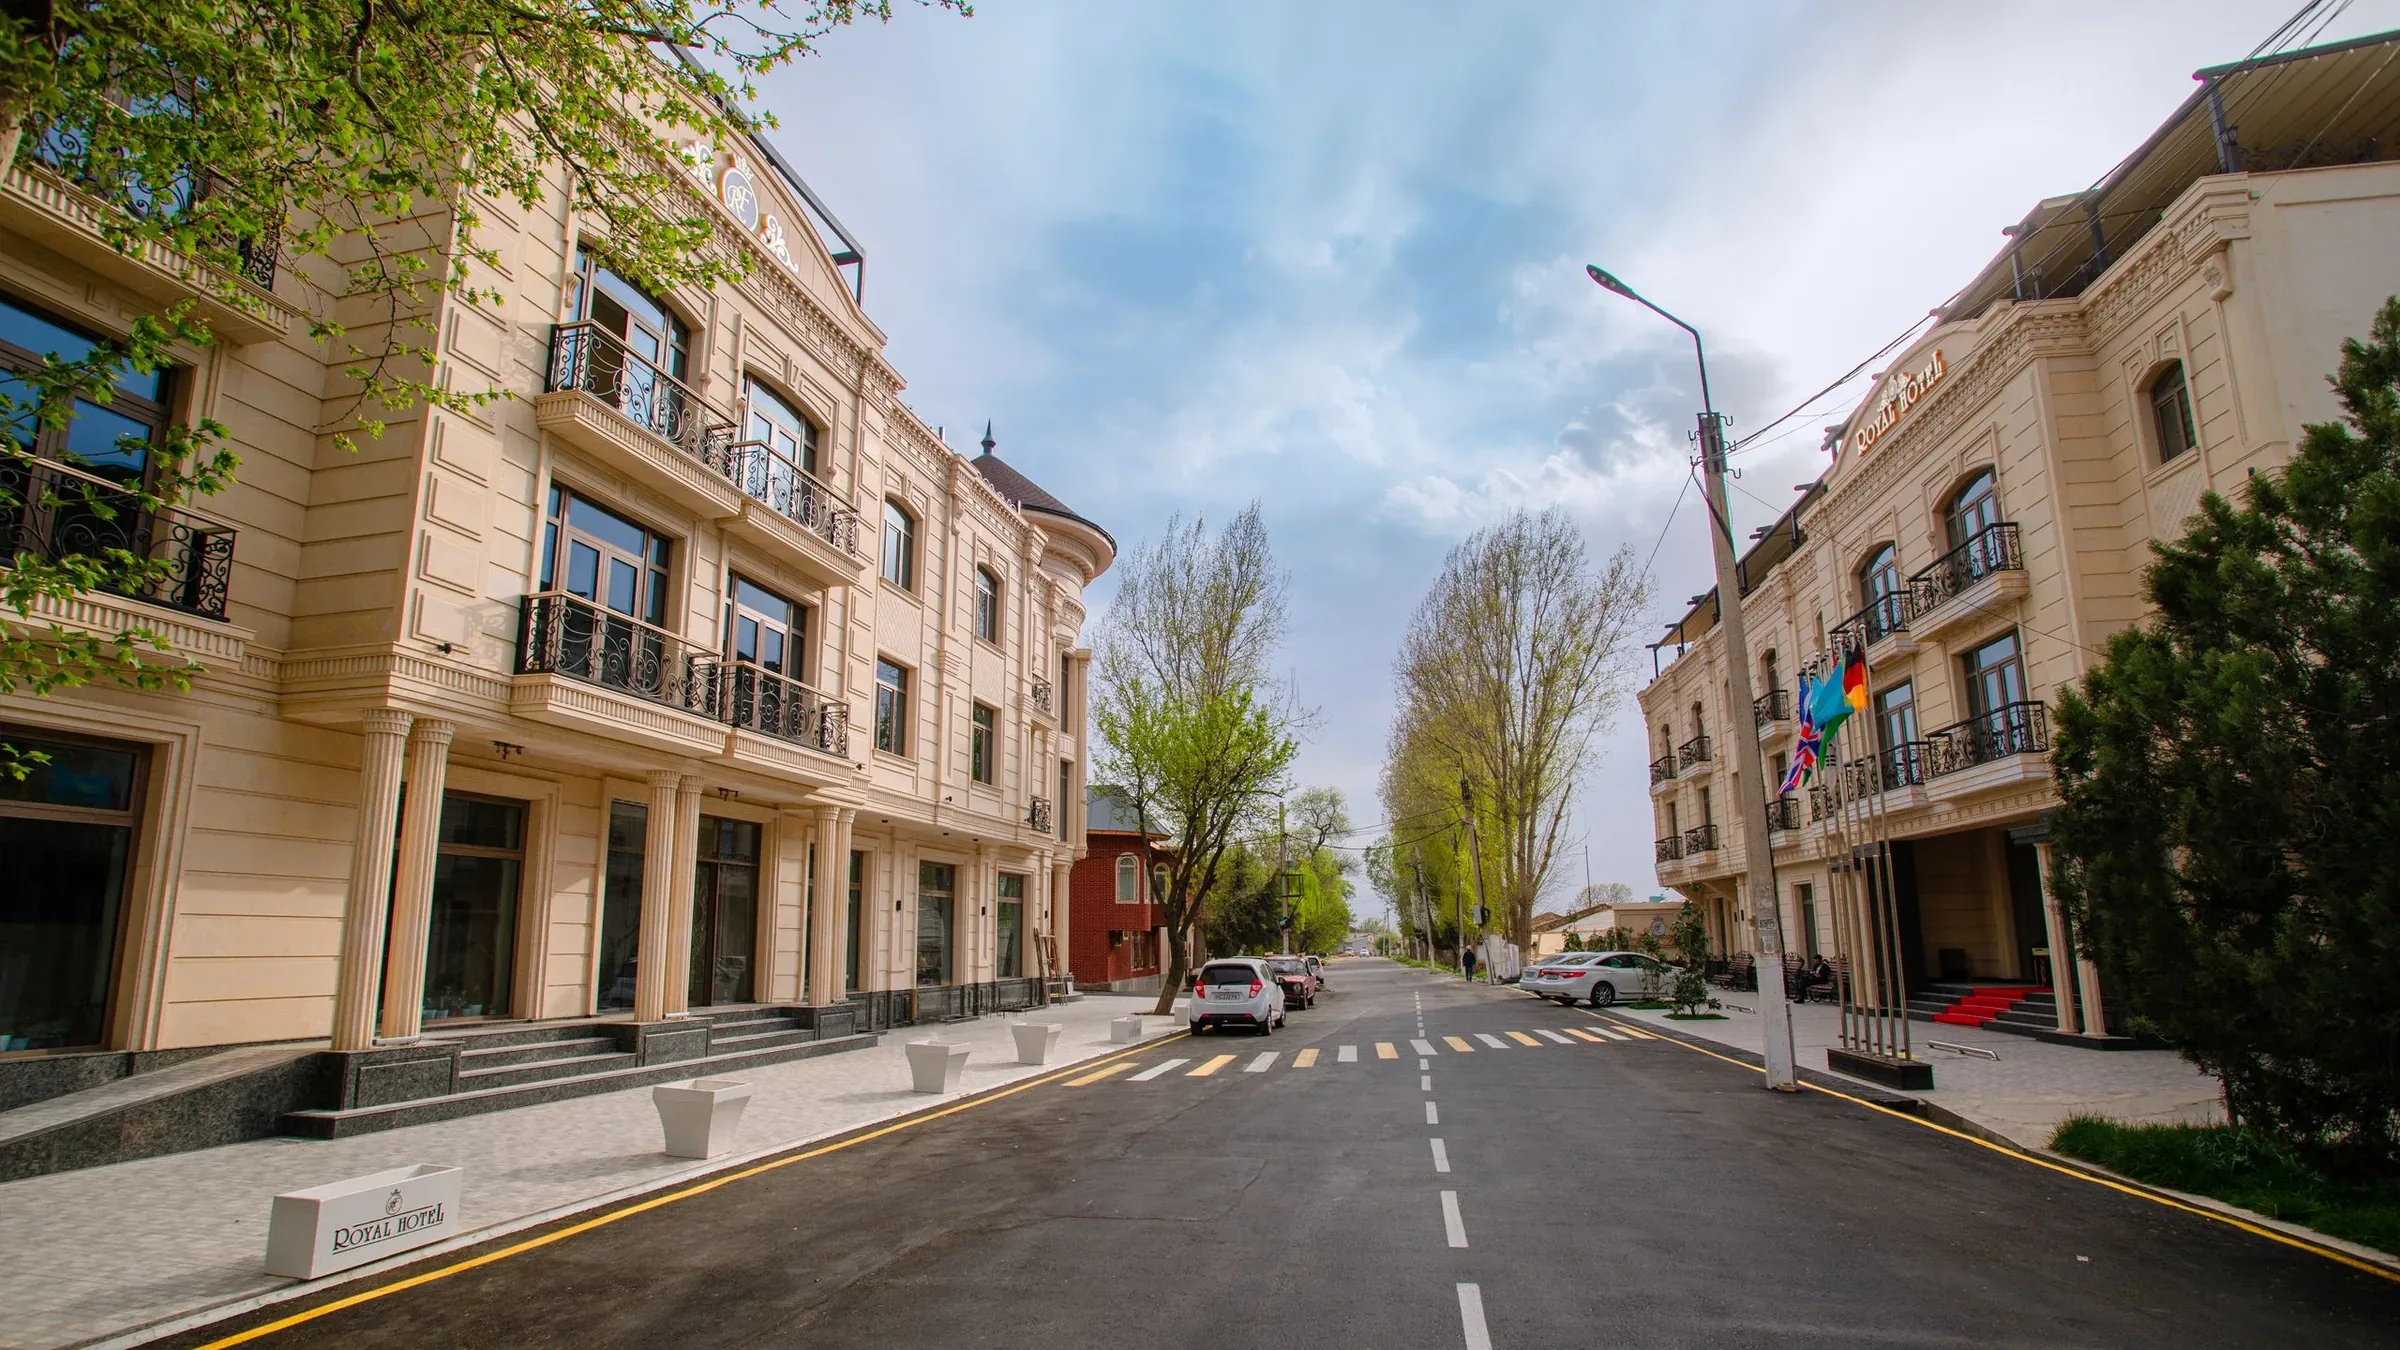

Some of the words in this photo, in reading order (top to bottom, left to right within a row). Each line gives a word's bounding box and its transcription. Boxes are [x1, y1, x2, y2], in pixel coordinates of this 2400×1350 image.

[1855, 403, 1899, 457] ROYAL
[1899, 349, 1946, 414] HOTEL
[332, 1221, 391, 1251] ROYAL
[398, 1202, 444, 1233] HOTEL
